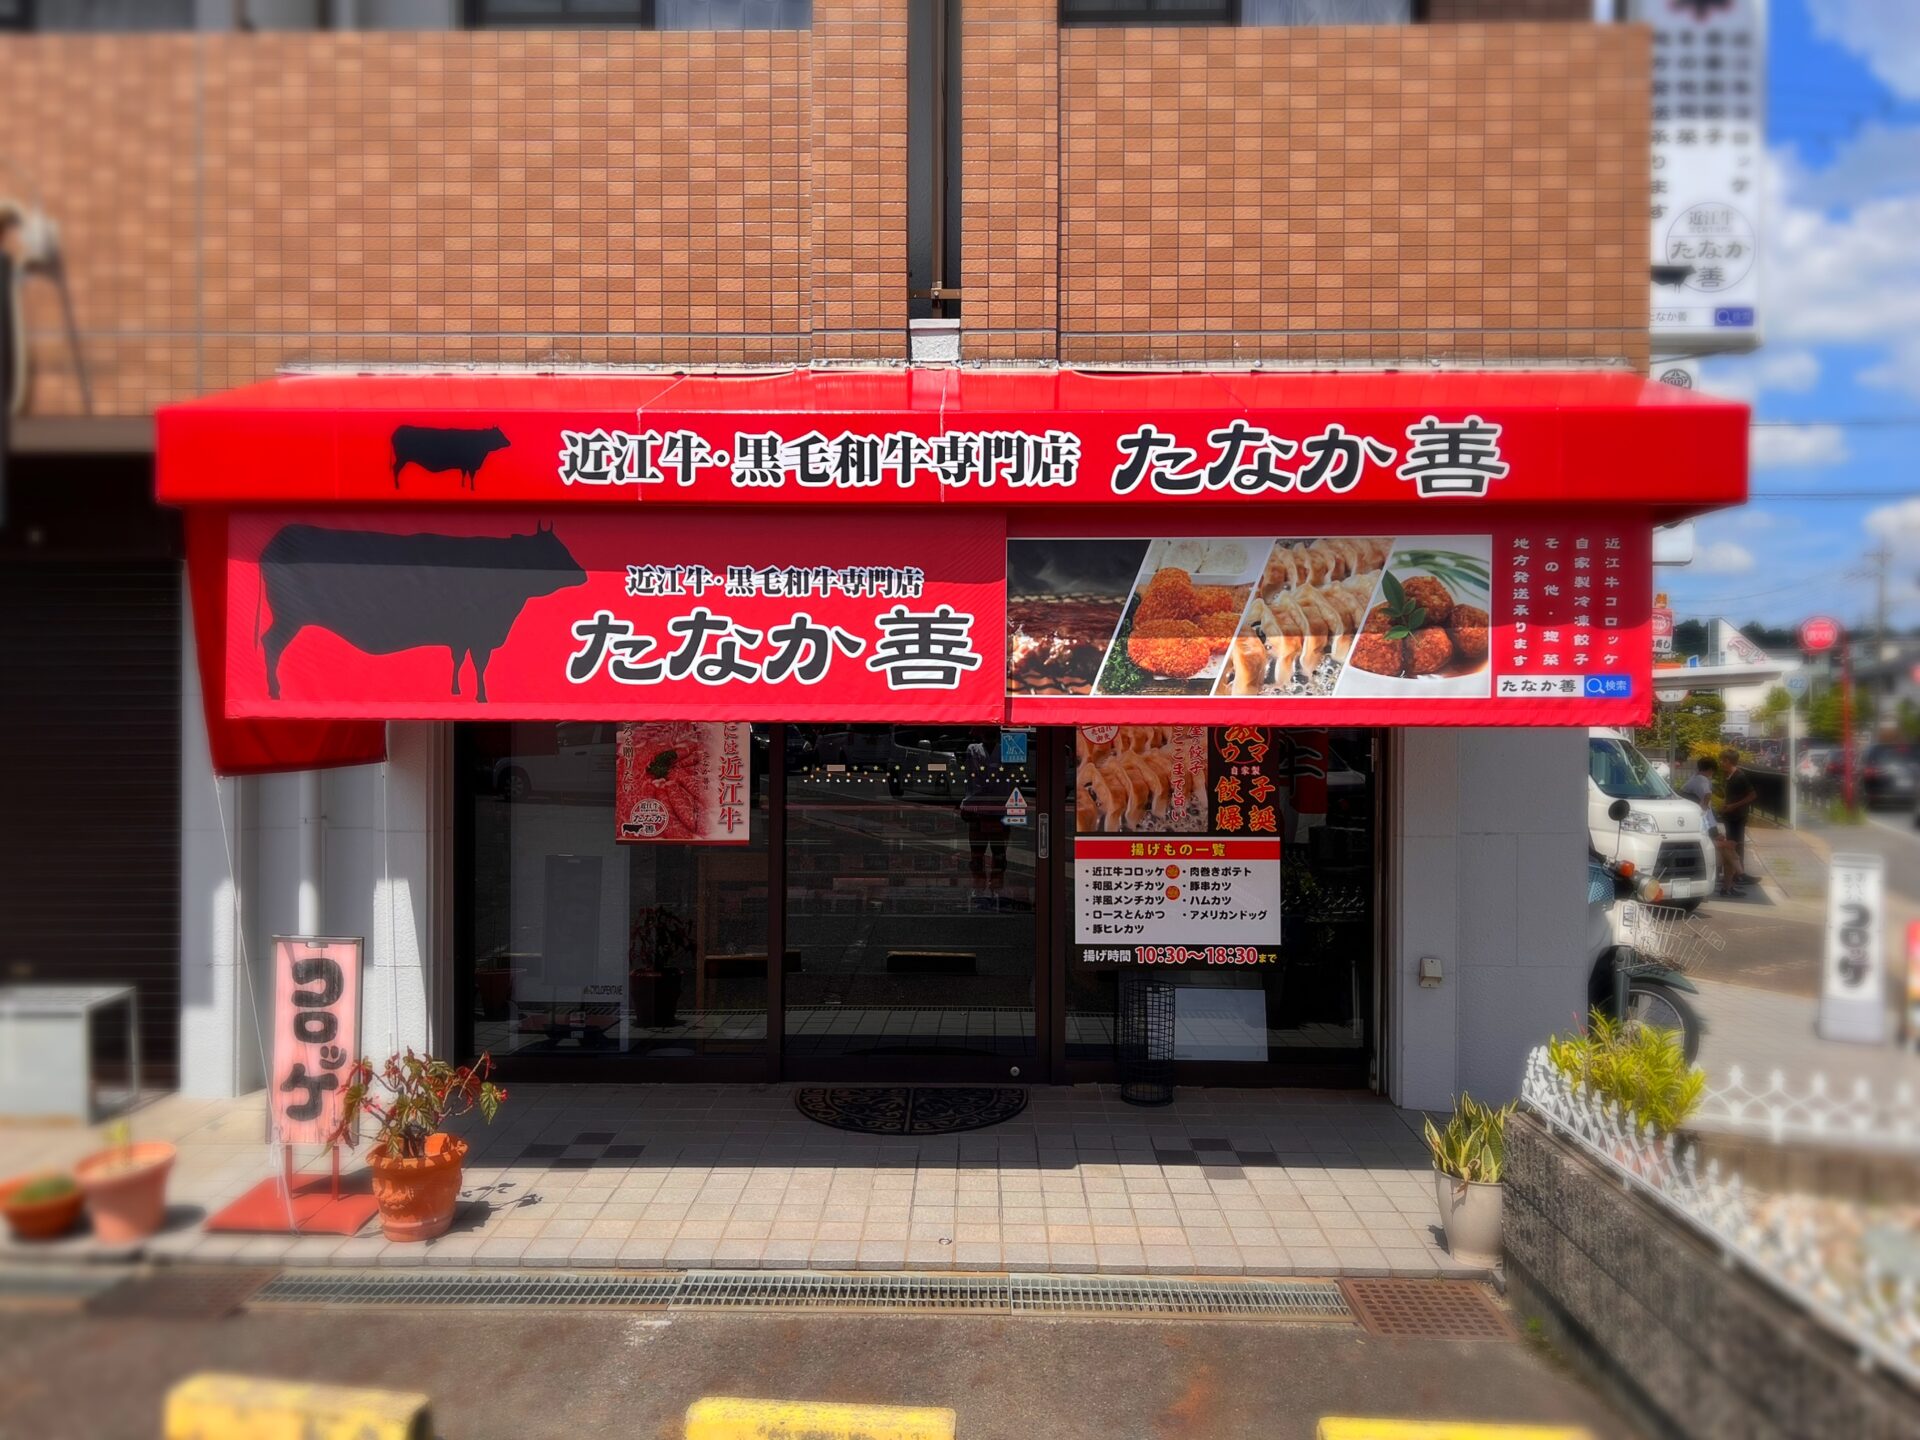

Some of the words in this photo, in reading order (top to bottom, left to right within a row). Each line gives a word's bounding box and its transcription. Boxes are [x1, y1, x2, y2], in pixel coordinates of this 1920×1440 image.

[1670, 239, 1749, 260] たなか
[1696, 265, 1726, 288] 善
[558, 428, 1081, 488] 近江牛・黒毛和牛専門店
[1111, 415, 1509, 498] たなか善
[624, 563, 924, 599] 近江牛・黒毛和牛専門店
[1512, 537, 1531, 667] 地方発送承ります
[1573, 537, 1591, 666] 自家製冷凍餃子
[1603, 537, 1621, 665] 近江牛コロッケ
[566, 604, 983, 691] たなか善
[1502, 678, 1576, 693] たなか善
[1605, 680, 1627, 691] 検索
[622, 722, 635, 793] ろを贈りたい
[1230, 765, 1261, 776] 自家製
[1215, 775, 1276, 803] 餃子
[1215, 804, 1278, 833] 爆誕
[1130, 843, 1226, 857] 揚げもの一覧
[1083, 949, 1131, 963] 揚げ時間
[280, 958, 347, 1121] コロッケ
